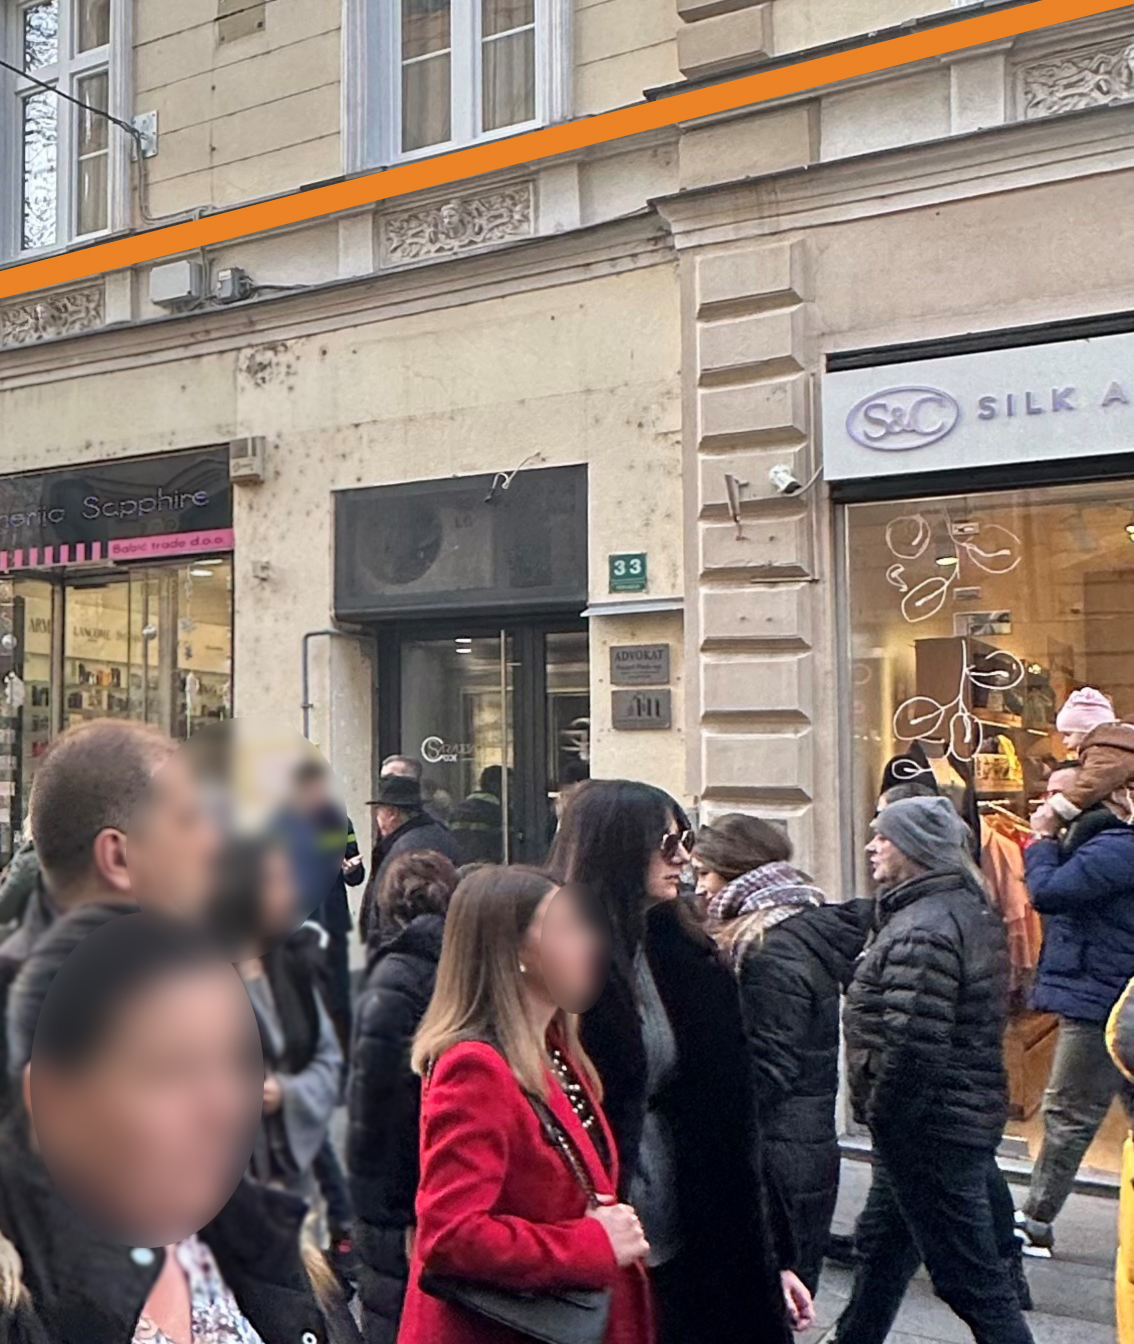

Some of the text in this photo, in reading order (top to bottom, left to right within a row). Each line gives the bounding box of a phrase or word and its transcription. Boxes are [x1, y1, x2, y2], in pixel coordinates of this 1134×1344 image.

[863, 395, 945, 440] S&C
[977, 387, 1076, 420] SILK
[82, 487, 210, 520] Sapphire
[151, 538, 186, 550] trade
[190, 536, 225, 547] d.o.o.
[613, 558, 642, 576] 33
[615, 649, 664, 661] ADVOKAT
